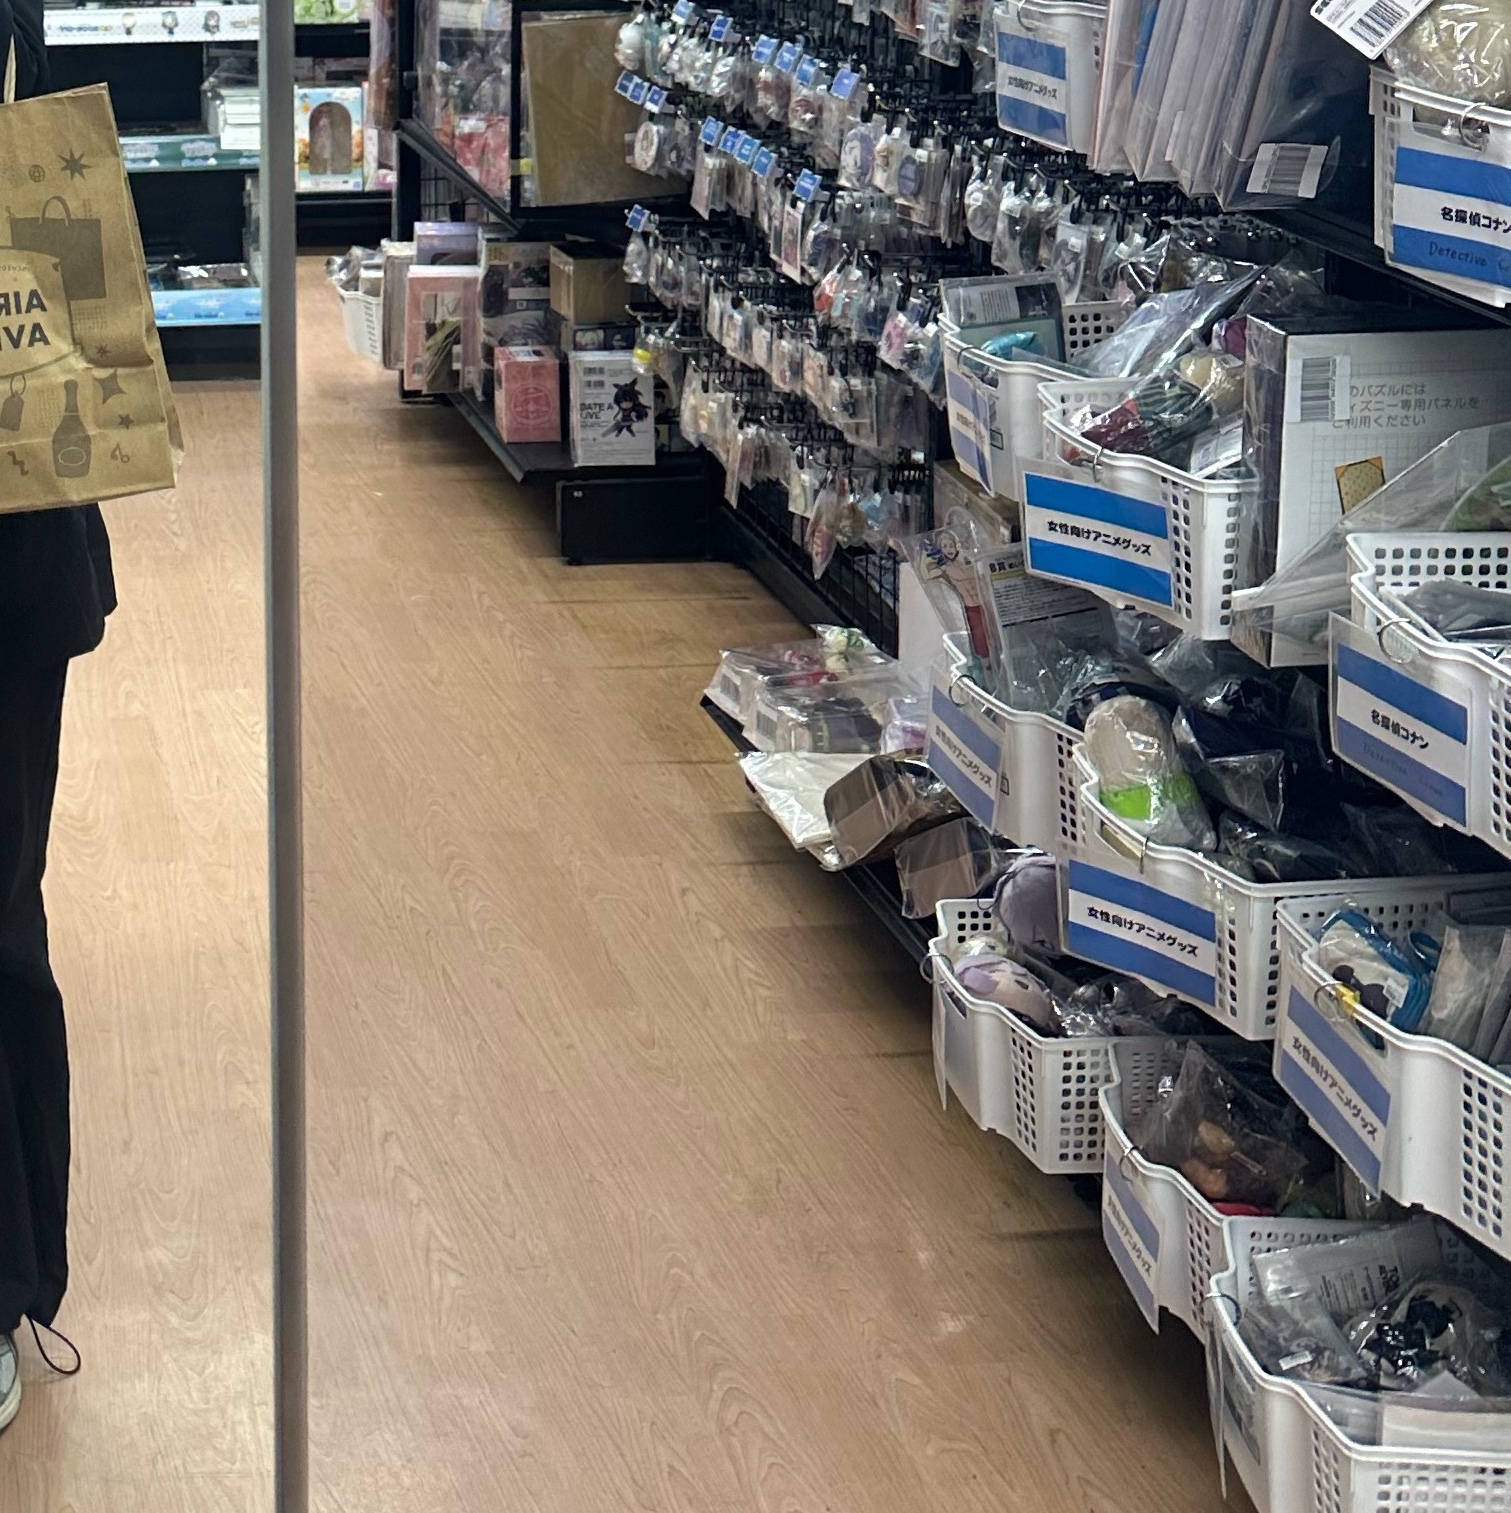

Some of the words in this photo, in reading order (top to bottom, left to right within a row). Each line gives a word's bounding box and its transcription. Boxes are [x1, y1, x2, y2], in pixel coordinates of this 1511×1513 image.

[1440, 206, 1511, 233] 名探偵コナン
[1429, 241, 1488, 266] Detective
[1350, 383, 1426, 397] のパズルには
[1047, 521, 1152, 557] 女性向けアニメグッズ
[1370, 709, 1429, 750] 名探偵コナン
[934, 725, 993, 788] 女性向けアニメグッズ
[1087, 906, 1199, 958] 女性向けアニメグッズ
[1292, 1035, 1379, 1143] 女性向けアニメグッズ
